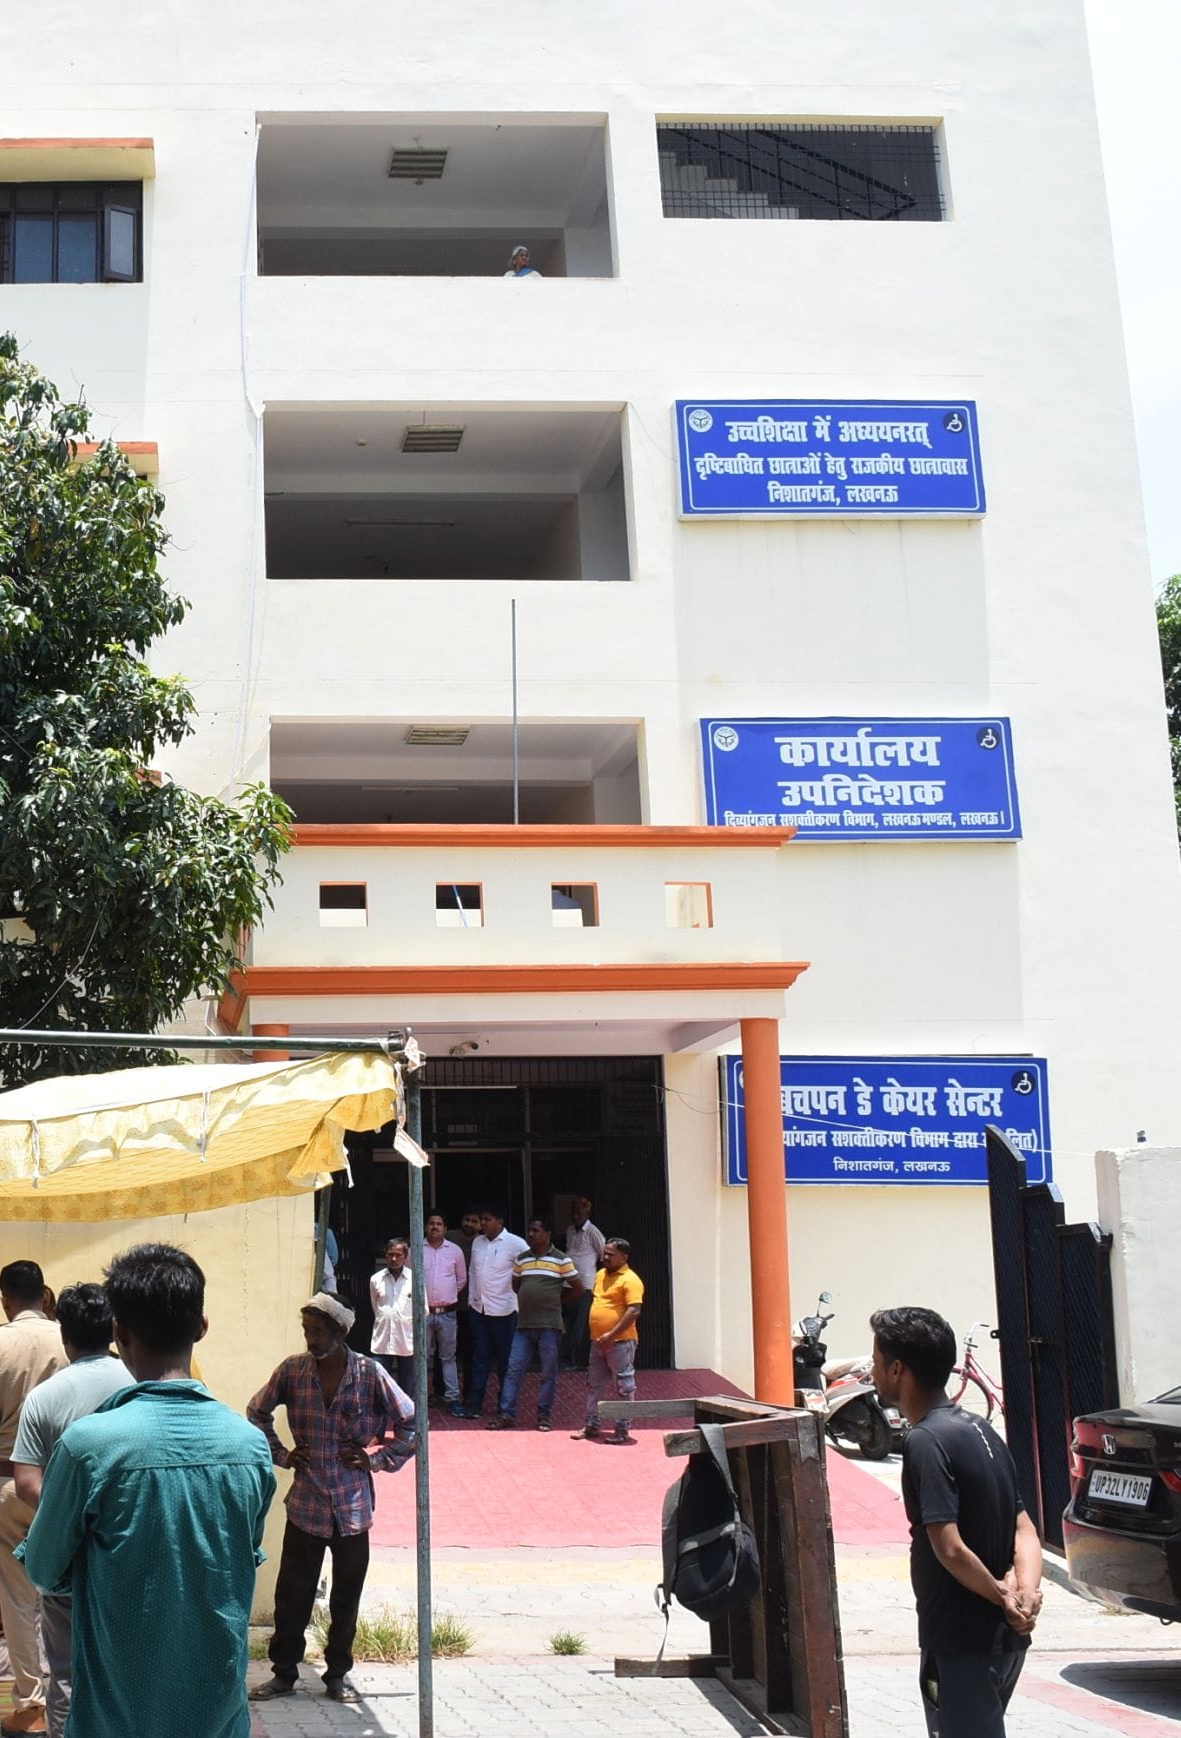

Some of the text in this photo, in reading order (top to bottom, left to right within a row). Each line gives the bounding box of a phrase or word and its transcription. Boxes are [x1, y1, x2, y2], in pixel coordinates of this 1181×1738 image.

[724, 415, 807, 443] उच्चशिक्षा
[812, 415, 832, 443] में
[839, 419, 933, 449] अध्ययनरत्
[694, 452, 968, 480] दृष्टिबाधित छात्राओं हेतु राजकीय छात्रावास
[767, 480, 899, 506] निशातगंज, लखनऊ
[774, 727, 941, 767] कार्यालय
[777, 774, 946, 807] उपनिदेशक
[841, 810, 879, 829] विभाग,
[852, 1077, 873, 1116] डे
[880, 1077, 937, 1117] केयर
[944, 1078, 1003, 1118] सेन्टर
[833, 1156, 951, 1175] निशातगंज, लखनऊ
[1094, 1474, 1149, 1501] UP32LY1906
